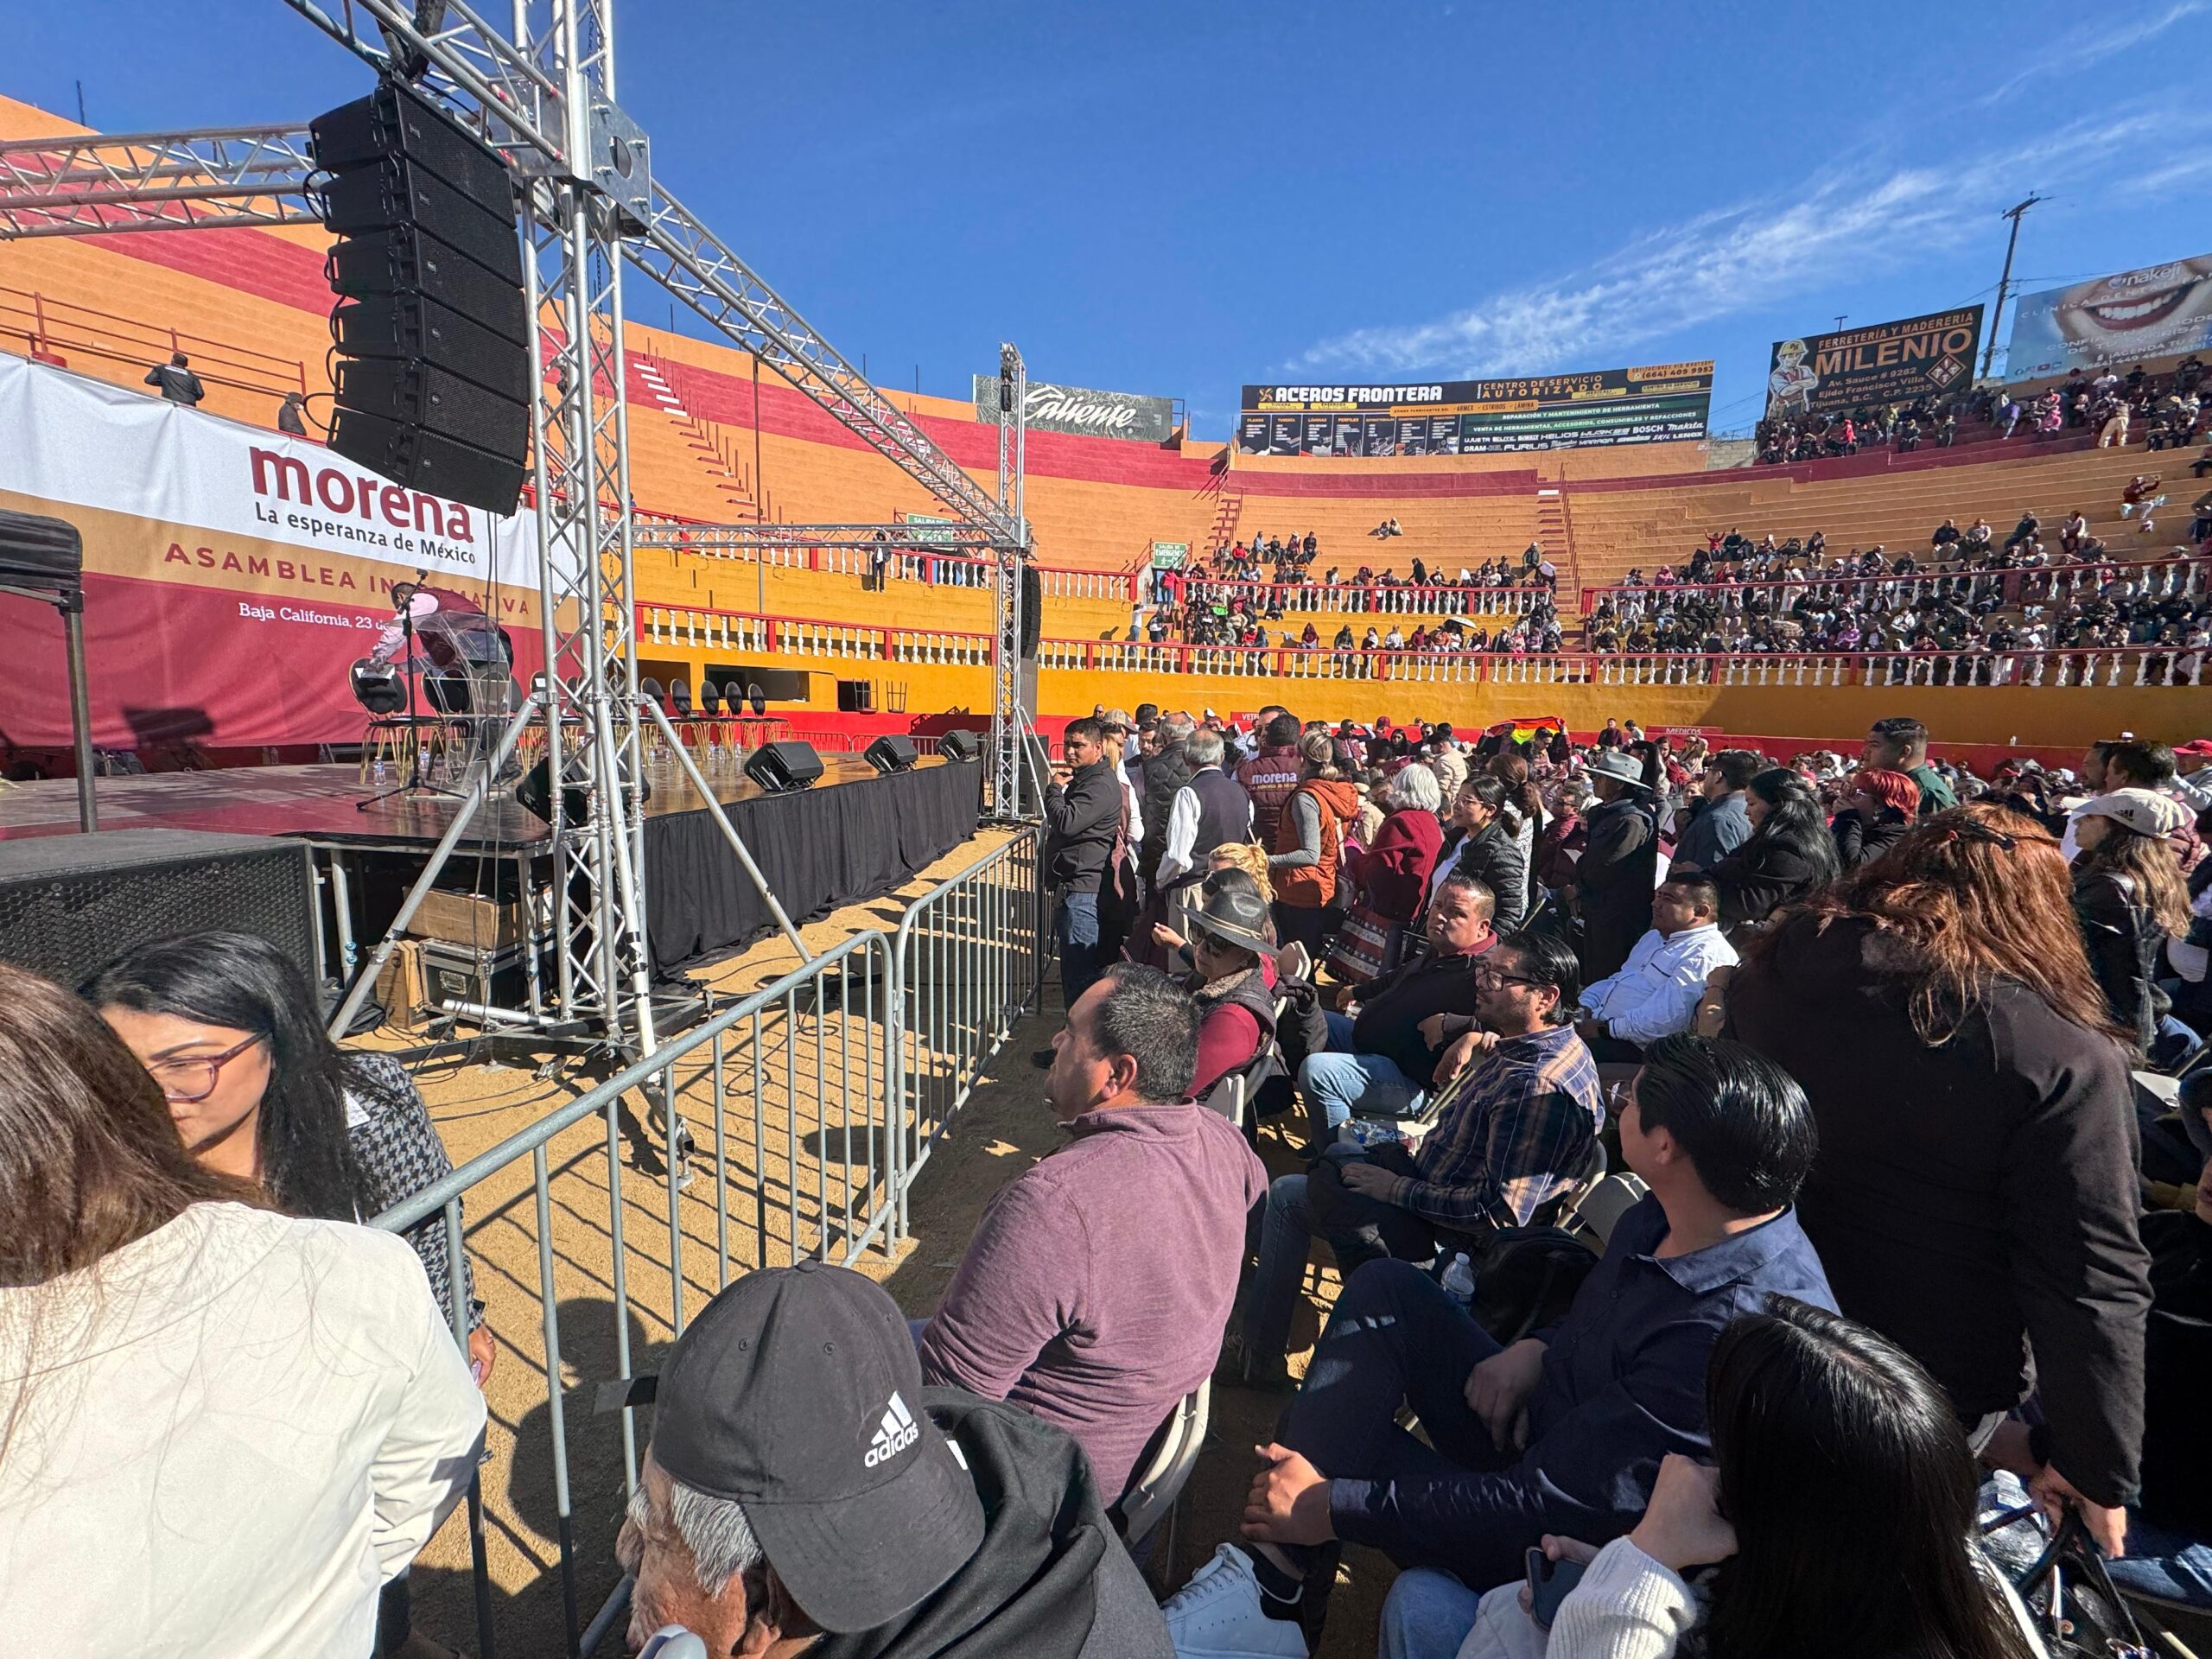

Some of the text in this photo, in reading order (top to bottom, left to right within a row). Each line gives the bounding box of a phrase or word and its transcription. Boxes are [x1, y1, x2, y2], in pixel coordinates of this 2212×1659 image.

[1891, 327, 1899, 336] Y
[1815, 328, 1972, 377] MILENIO
[2068, 346, 2088, 355] DE
[1484, 381, 1526, 391] CENTRO
[1549, 374, 1602, 386] SERVICIO
[1818, 376, 1926, 399] Ejido Francisco Villa
[1827, 379, 1842, 388] Av.
[1846, 375, 1878, 385] Sauce
[1275, 385, 1442, 402] ACEROS FRONTERA
[1482, 383, 1602, 399] AUTORIZADO
[1024, 385, 1137, 429] Caliente
[1548, 409, 1601, 418] MANTENIMIENTO
[1612, 403, 1660, 412] HERRAMIENTA
[1597, 416, 1643, 425] CONSUMIBLES
[1650, 411, 1696, 421] REFACCIONES
[1633, 424, 1663, 434] BOSCH
[249, 446, 474, 543] morena
[256, 501, 475, 563] La esperanza de México
[164, 543, 356, 589] ASAMBLEA
[238, 602, 276, 621] Baja
[280, 607, 353, 628] California,
[355, 615, 372, 629] 23
[1251, 772, 1298, 785] morena
[864, 1421, 918, 1467] adidas
